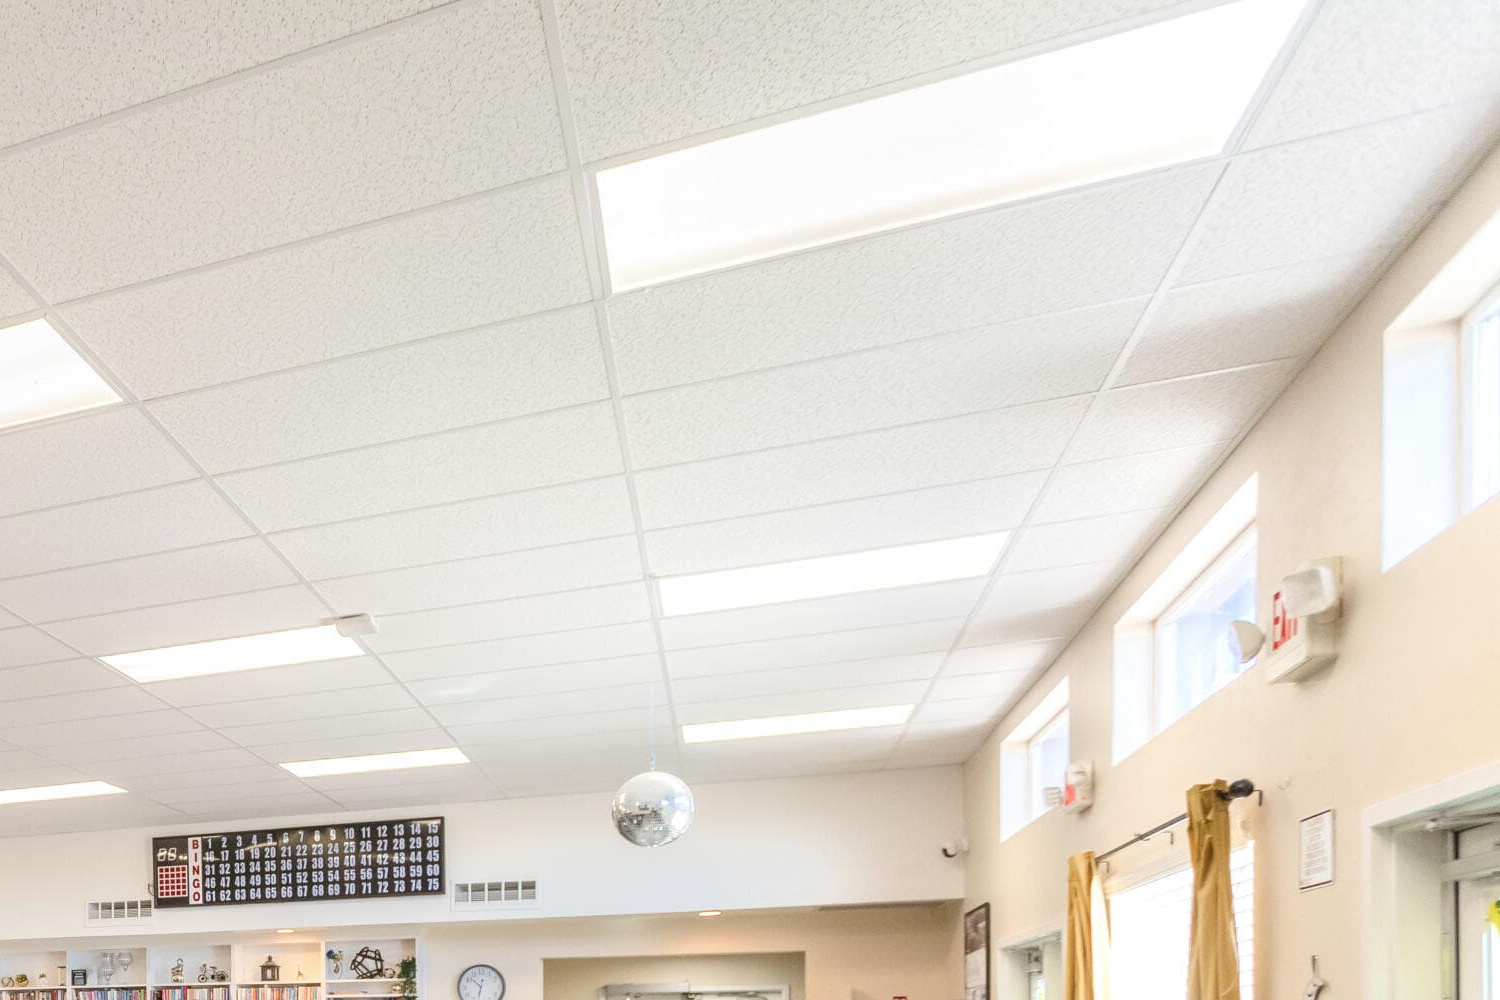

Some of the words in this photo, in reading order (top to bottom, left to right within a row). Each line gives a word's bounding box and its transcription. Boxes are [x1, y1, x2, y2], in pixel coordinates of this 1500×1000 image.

[207, 838, 212, 848] 1
[221, 837, 227, 848] 2
[237, 836, 242, 847] 3
[252, 835, 257, 845] 4
[267, 834, 273, 844] 5
[299, 831, 303, 842] 7
[344, 828, 354, 839] 10
[362, 827, 370, 838] 11
[377, 826, 387, 837] 12
[394, 824, 404, 836] 13
[411, 824, 420, 834] 14
[428, 823, 438, 833] 15
[205, 851, 214, 861] 16
[220, 850, 229, 861] 17
[235, 849, 244, 860] 18
[250, 848, 259, 858] 19
[264, 847, 276, 858] 20
[281, 846, 291, 856] 21
[296, 845, 307, 856] 22
[312, 844, 323, 854] 23
[328, 843, 338, 854] 24
[344, 842, 355, 853] 25
[360, 841, 371, 852] 26
[377, 840, 388, 851] 27
[393, 838, 405, 850] 28
[410, 837, 422, 848] 29
[427, 836, 439, 847] 30
[192, 839, 201, 902] BINGO
[205, 864, 215, 875] 31
[220, 864, 230, 874] 32
[235, 862, 245, 873] 33
[250, 861, 260, 872] 34
[265, 860, 276, 872] 35
[281, 859, 292, 870] 36
[297, 858, 307, 870] 37
[312, 857, 323, 869] 38
[328, 856, 339, 868] 39
[344, 855, 355, 866] 40
[361, 854, 371, 866] 41
[377, 854, 388, 864] 42
[393, 852, 405, 864] 43
[410, 851, 422, 862] 44
[427, 850, 439, 861] 45
[205, 878, 216, 888] 46
[220, 877, 230, 887] 47
[235, 876, 246, 886] 48
[250, 875, 261, 886] 49
[265, 874, 276, 885] 50
[282, 873, 291, 884] 51
[297, 872, 308, 883] 52
[312, 871, 323, 882] 53
[328, 870, 339, 881] 54
[344, 869, 356, 880] 55
[360, 868, 372, 880] 56
[378, 868, 388, 879] 57
[394, 866, 405, 878] 58
[410, 865, 422, 877] 59
[427, 864, 439, 876] 60
[206, 891, 215, 901] 61
[220, 890, 231, 901] 62
[235, 889, 246, 900] 63
[250, 888, 261, 899] 64
[266, 887, 276, 898] 65
[281, 887, 292, 898] 66
[298, 886, 307, 897] 67
[312, 885, 324, 896] 68
[328, 884, 340, 895] 69
[345, 883, 355, 894] 70
[362, 882, 371, 894] 71
[378, 882, 388, 893] 72
[394, 880, 405, 892] 73
[411, 880, 422, 891] 74
[428, 878, 439, 890] 75
